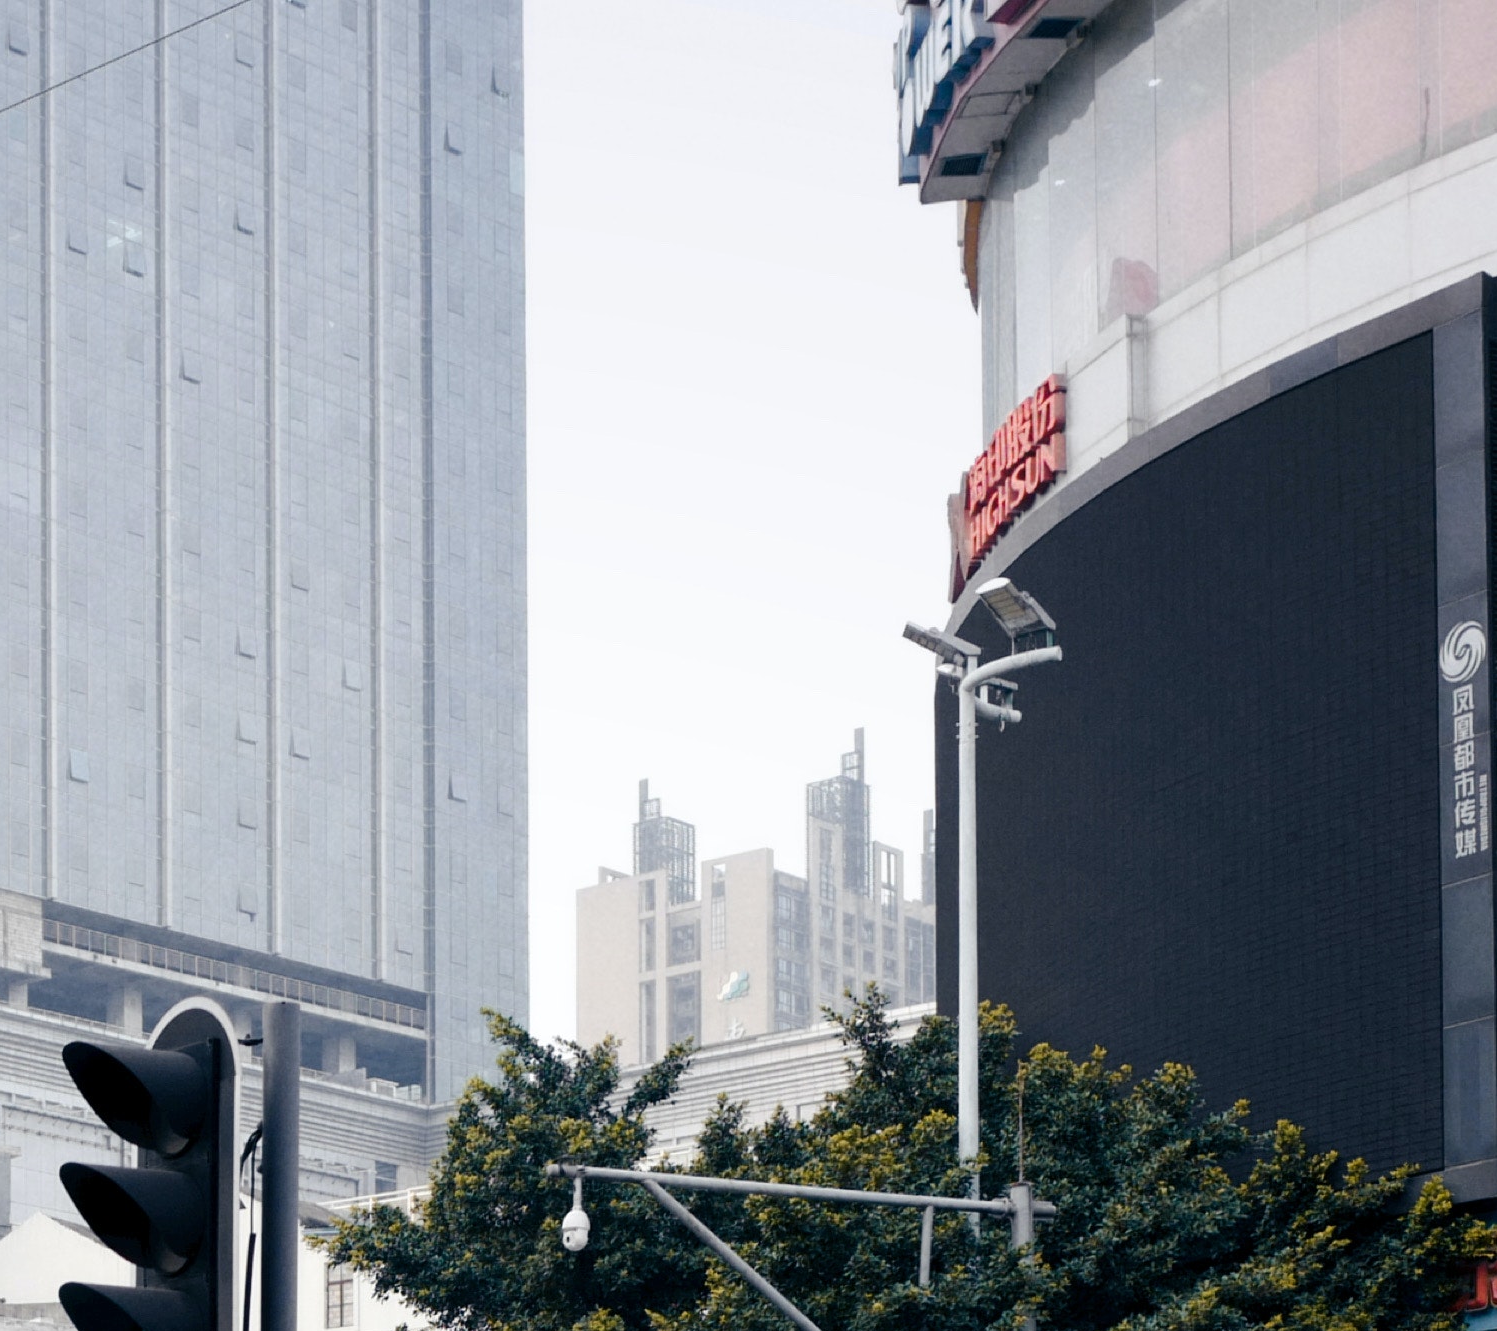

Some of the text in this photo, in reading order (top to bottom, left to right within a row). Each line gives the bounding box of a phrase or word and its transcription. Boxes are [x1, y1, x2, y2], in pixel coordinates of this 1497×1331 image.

[969, 433, 1066, 560] HIGHSUN
[1452, 683, 1478, 859] 凤凰都市传媒
